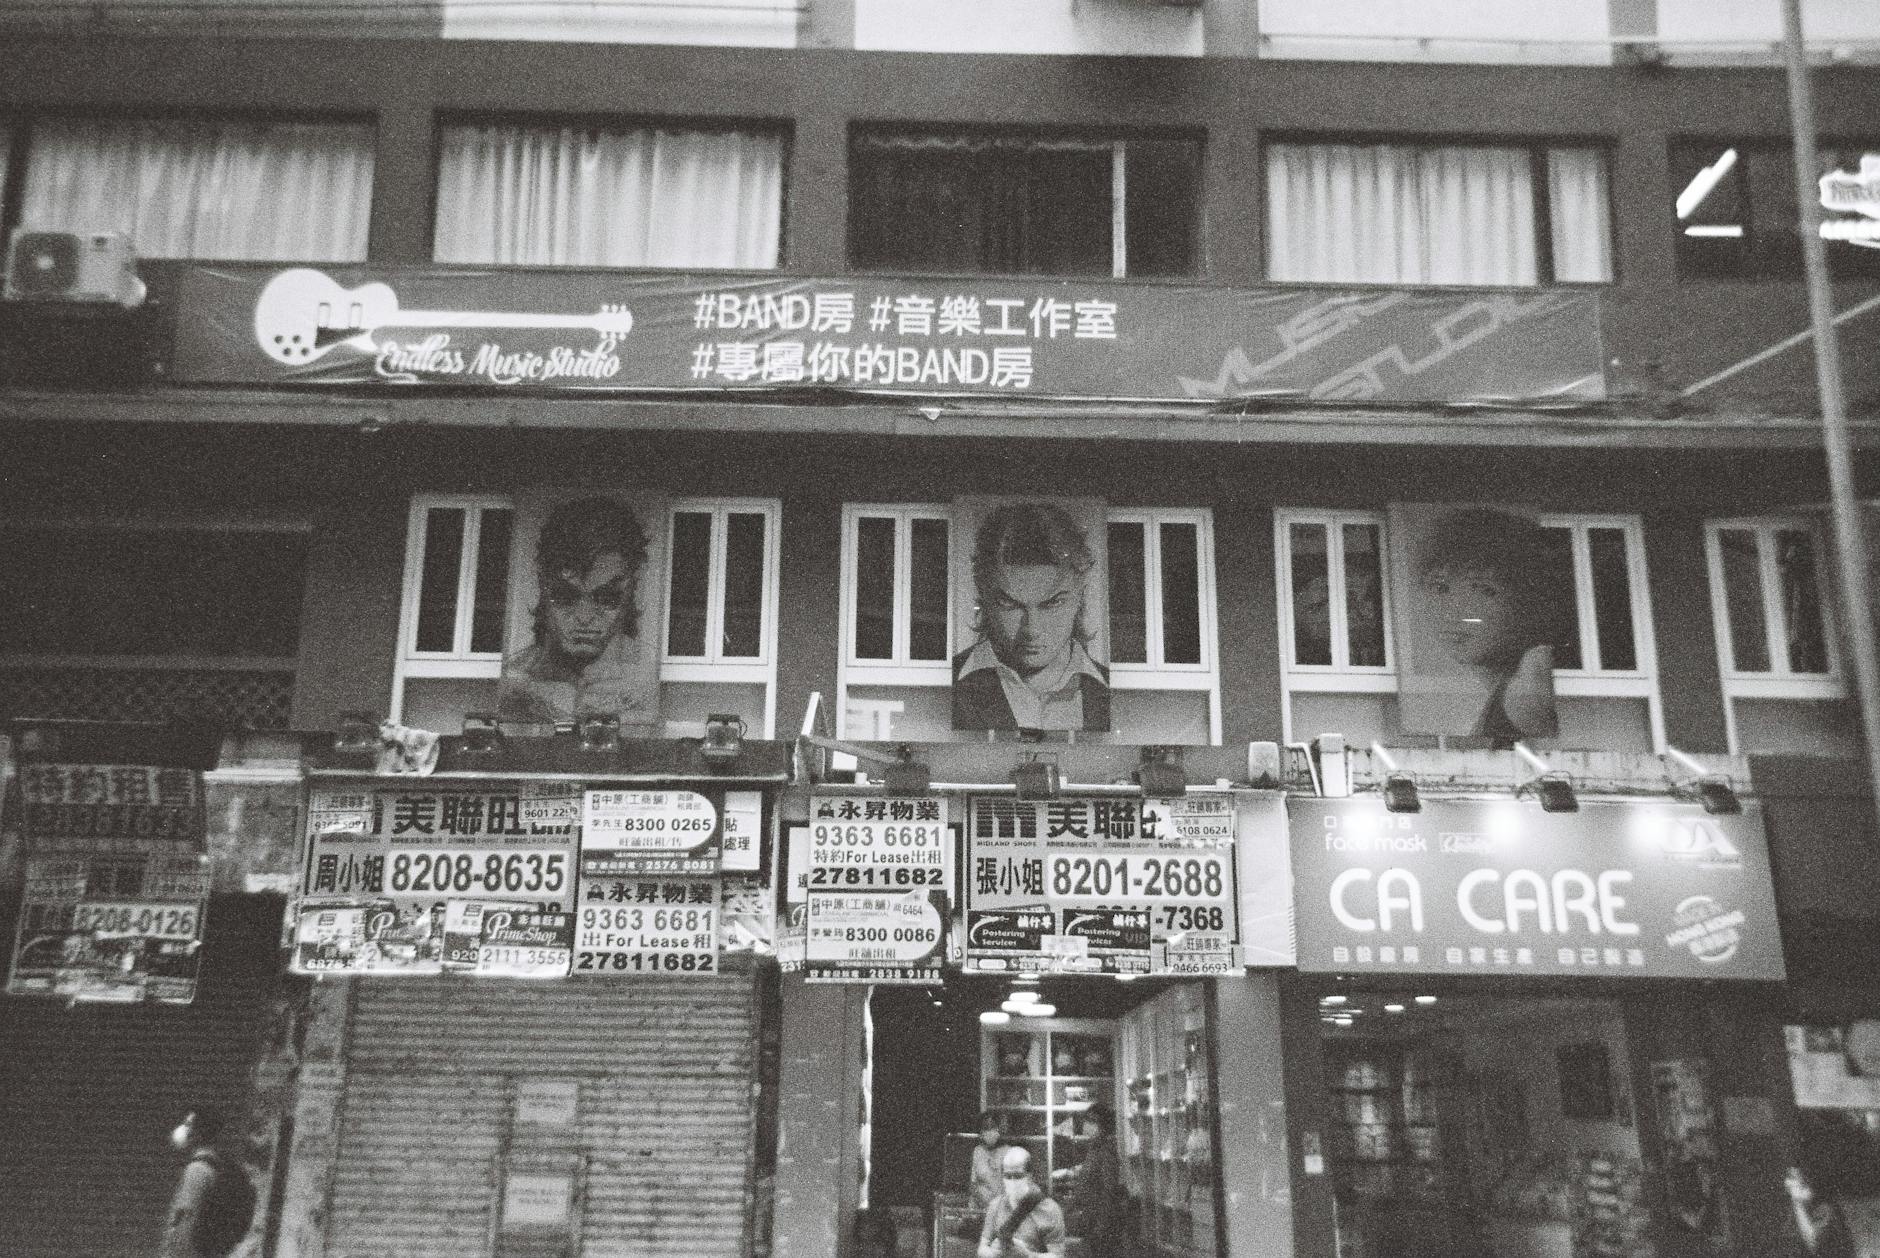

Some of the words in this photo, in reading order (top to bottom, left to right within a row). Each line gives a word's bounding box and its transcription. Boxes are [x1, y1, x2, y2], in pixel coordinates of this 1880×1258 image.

[694, 292, 854, 333] #BAND房
[869, 296, 1118, 338] #音樂工作室
[375, 333, 464, 384] Endless
[468, 343, 543, 385] Music
[541, 338, 621, 380] Studio
[691, 342, 1034, 389] #專屬你的BAND房
[838, 800, 940, 821] 永昇物業
[625, 818, 665, 832] 8300
[671, 818, 712, 832] 0265
[1203, 827, 1228, 835] 0624
[815, 825, 874, 847] 9363
[884, 826, 941, 847] 6681
[1325, 833, 1370, 850] face
[1373, 834, 1427, 851] mask
[314, 854, 384, 892] 周小姐
[391, 853, 565, 892] 8208-8635
[645, 860, 679, 871] 2576
[811, 867, 943, 885] 27811682
[976, 857, 1044, 895] 張小姐
[1053, 858, 1222, 897] 8201-2688
[608, 882, 713, 905] 永昇物業
[1329, 867, 1424, 933] CA
[1457, 868, 1640, 935] CARE
[583, 908, 643, 931] 9363
[654, 909, 712, 932] 6681
[606, 934, 634, 947] For
[640, 935, 690, 948] Lease
[846, 927, 888, 942] 8300
[894, 928, 936, 943] 0086
[483, 949, 520, 963] 2111
[578, 952, 714, 972] 27811682
[1201, 963, 1228, 973] 6693
